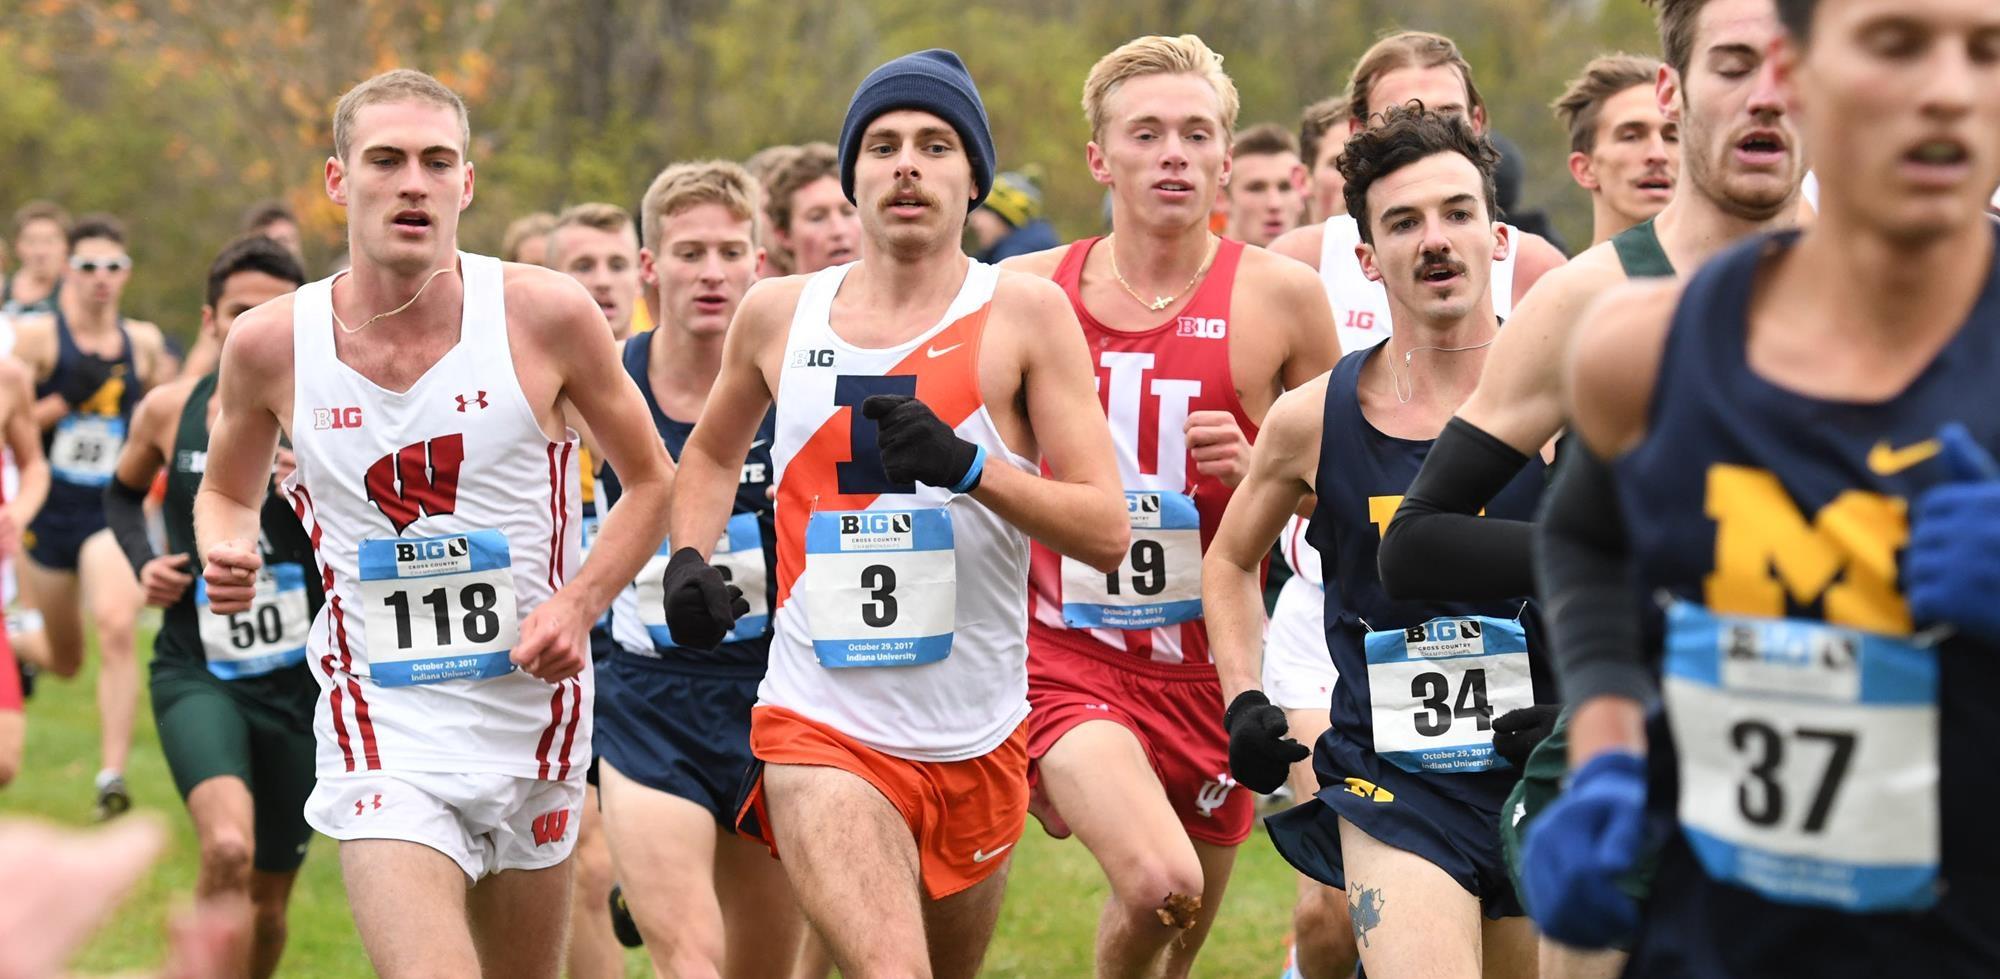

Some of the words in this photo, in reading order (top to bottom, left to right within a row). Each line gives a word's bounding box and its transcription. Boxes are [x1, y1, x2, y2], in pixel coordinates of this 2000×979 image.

[364, 432, 464, 537] W
[1705, 462, 1914, 635] M
[861, 564, 898, 628] 3
[384, 582, 500, 650] 118
[1102, 617, 1128, 625] Indiana
[1128, 616, 1166, 626] University
[1103, 607, 1131, 616] October
[1145, 607, 1164, 615] 2017
[228, 604, 283, 649] 50
[846, 653, 876, 661] Indiana
[877, 652, 917, 661] University
[848, 643, 879, 651] October
[881, 643, 893, 651] 29,
[894, 642, 914, 650] 2017
[411, 673, 440, 681] Indiana
[441, 669, 481, 679] University
[412, 662, 443, 671] October
[445, 661, 457, 669] 29,
[459, 658, 478, 667] 2017
[1411, 668, 1494, 737] 34
[1422, 751, 1455, 760] October
[1456, 750, 1470, 758] 29,
[1471, 748, 1492, 756] 2017
[1422, 761, 1453, 769] Indiana
[1453, 759, 1493, 768] University
[1729, 719, 1858, 835] 37
[531, 809, 569, 848] W
